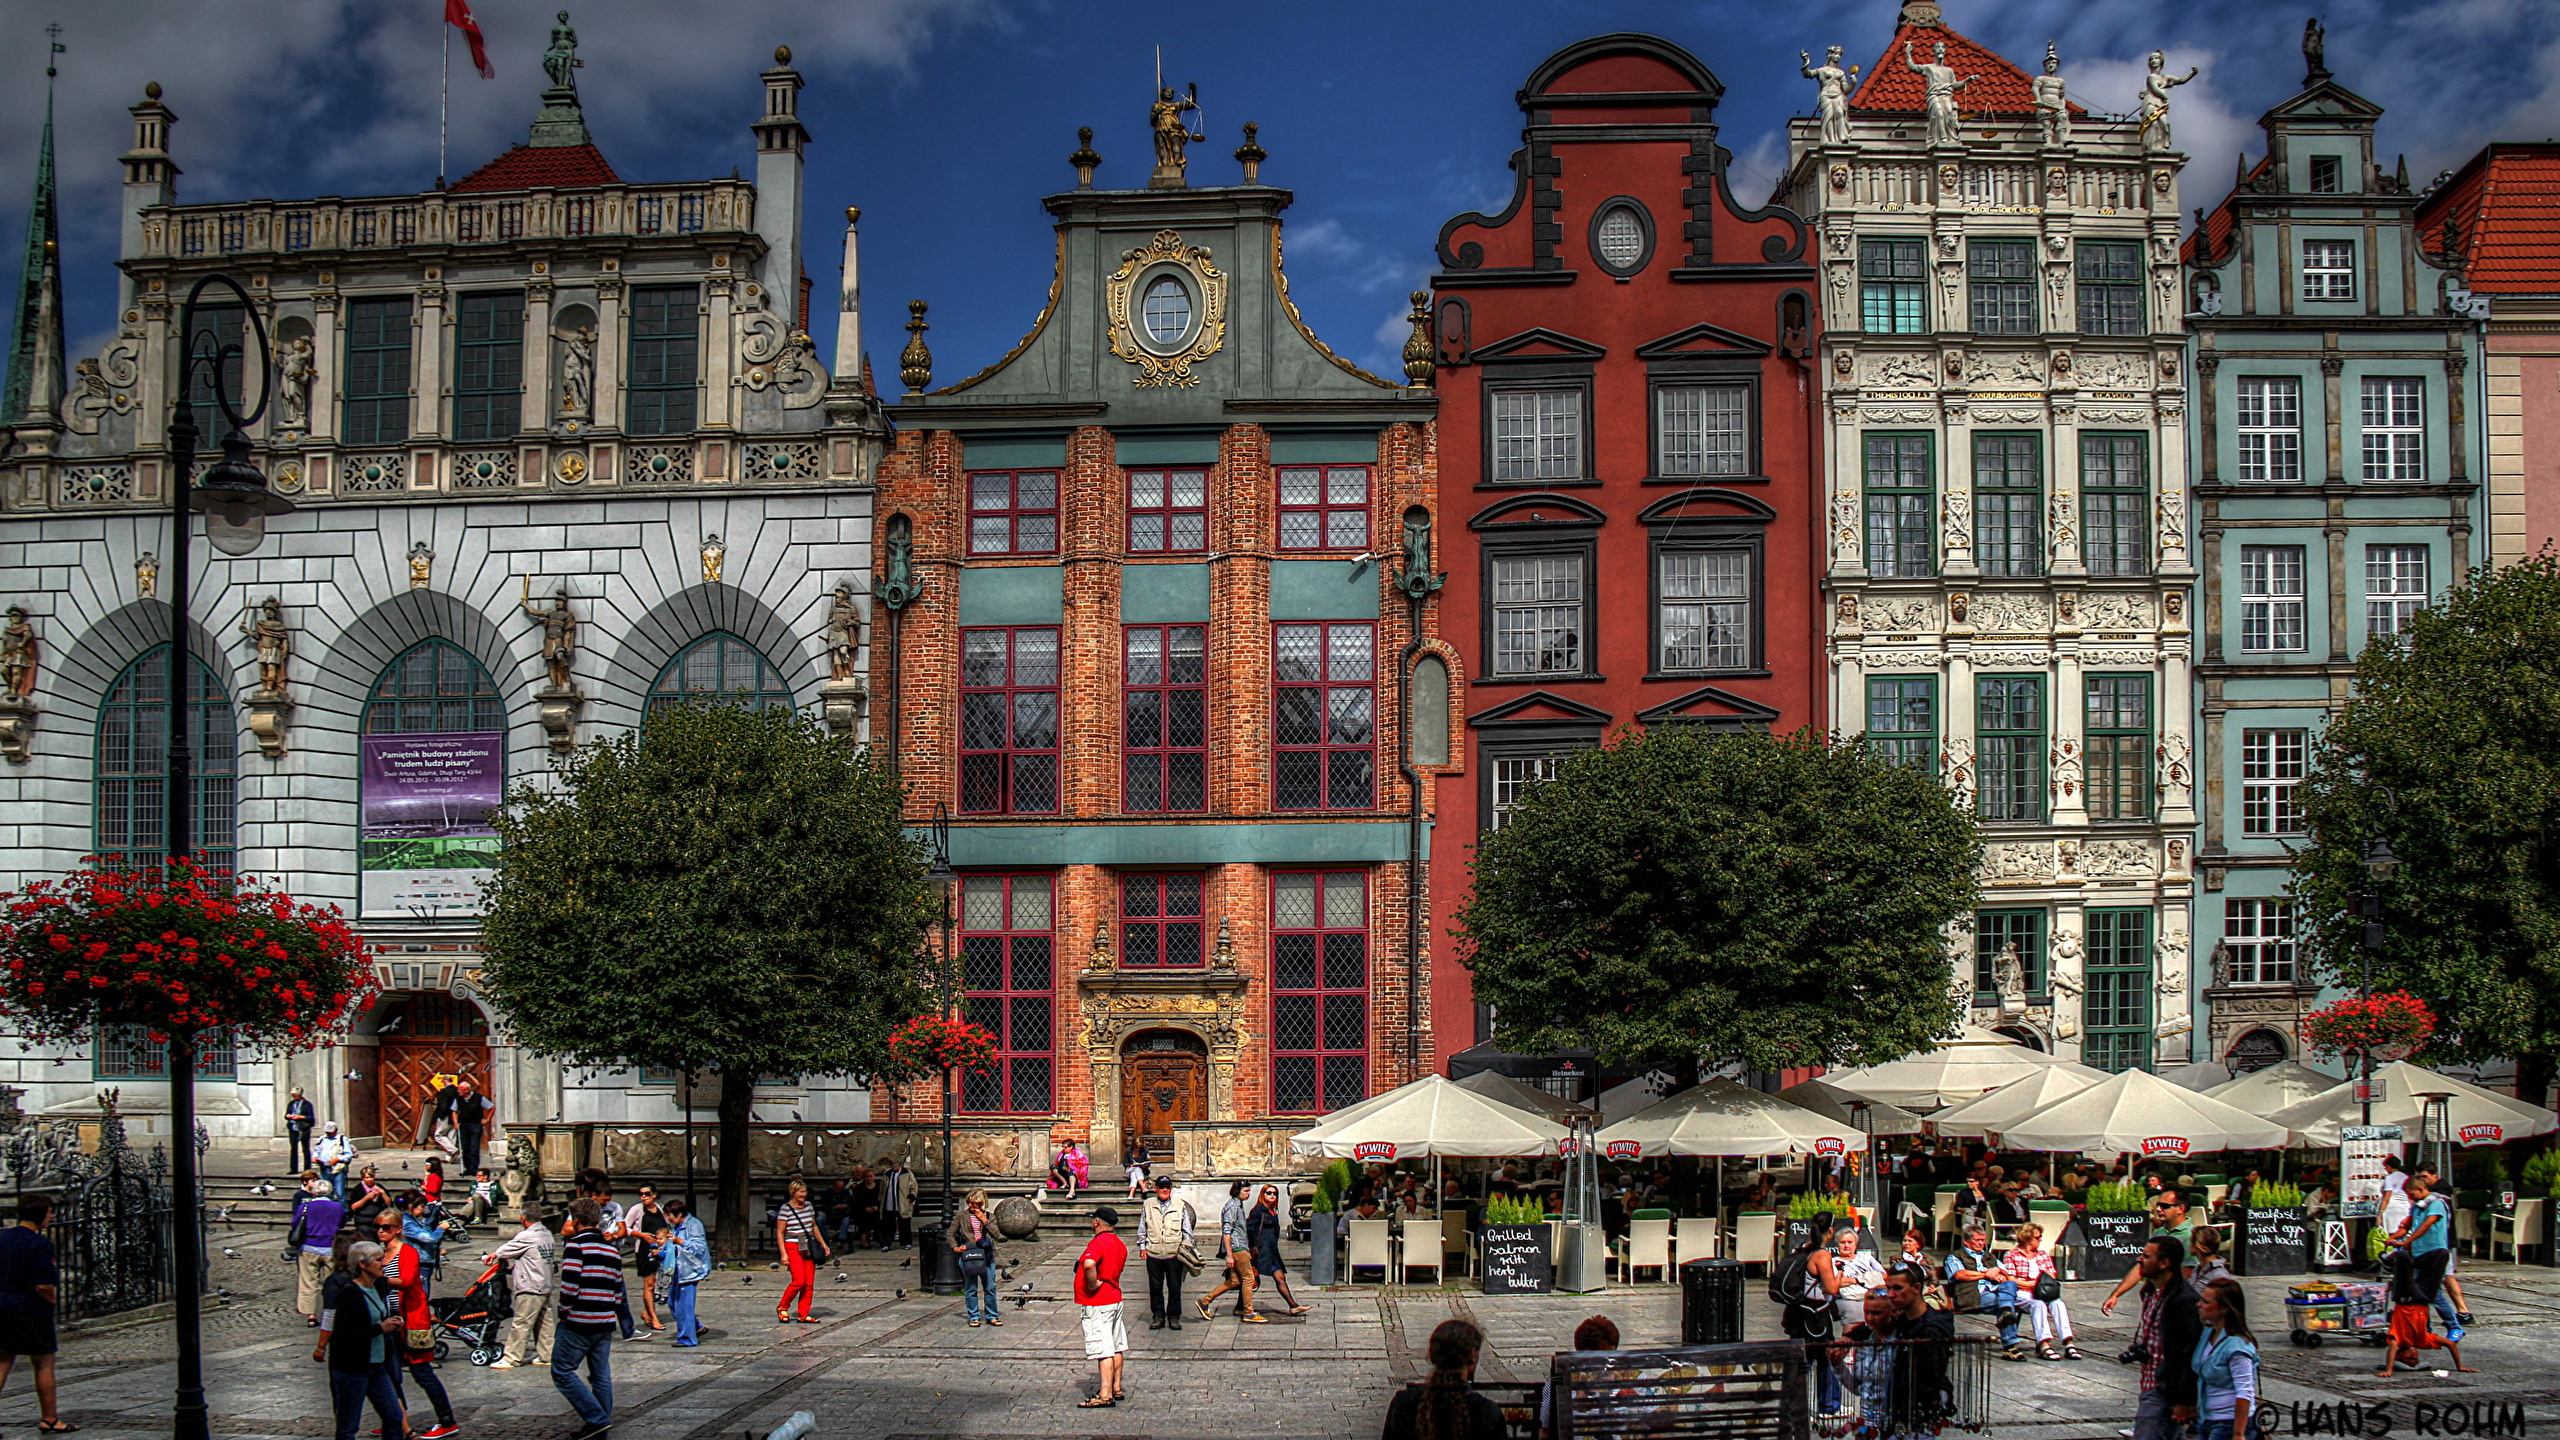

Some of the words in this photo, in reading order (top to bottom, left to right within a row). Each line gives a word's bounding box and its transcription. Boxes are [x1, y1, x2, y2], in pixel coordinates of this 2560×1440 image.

[421, 750, 454, 758] budowy
[455, 749, 489, 757] stadionu
[424, 759, 444, 767] ludzi
[2344, 1127, 2375, 1138] MENU
[2089, 1214, 2143, 1230] cappuccino
[1487, 1227, 1534, 1242] Grilled
[2246, 1222, 2278, 1235] Fried
[2281, 1224, 2305, 1239] eggs
[2090, 1233, 2116, 1249] caffe
[2247, 1234, 2273, 1246] with
[2274, 1234, 2305, 1247] bacon
[1488, 1243, 1541, 1256] salmon
[1499, 1253, 1527, 1265] with
[1488, 1264, 1515, 1277] herb
[1507, 1272, 1541, 1290] butter
